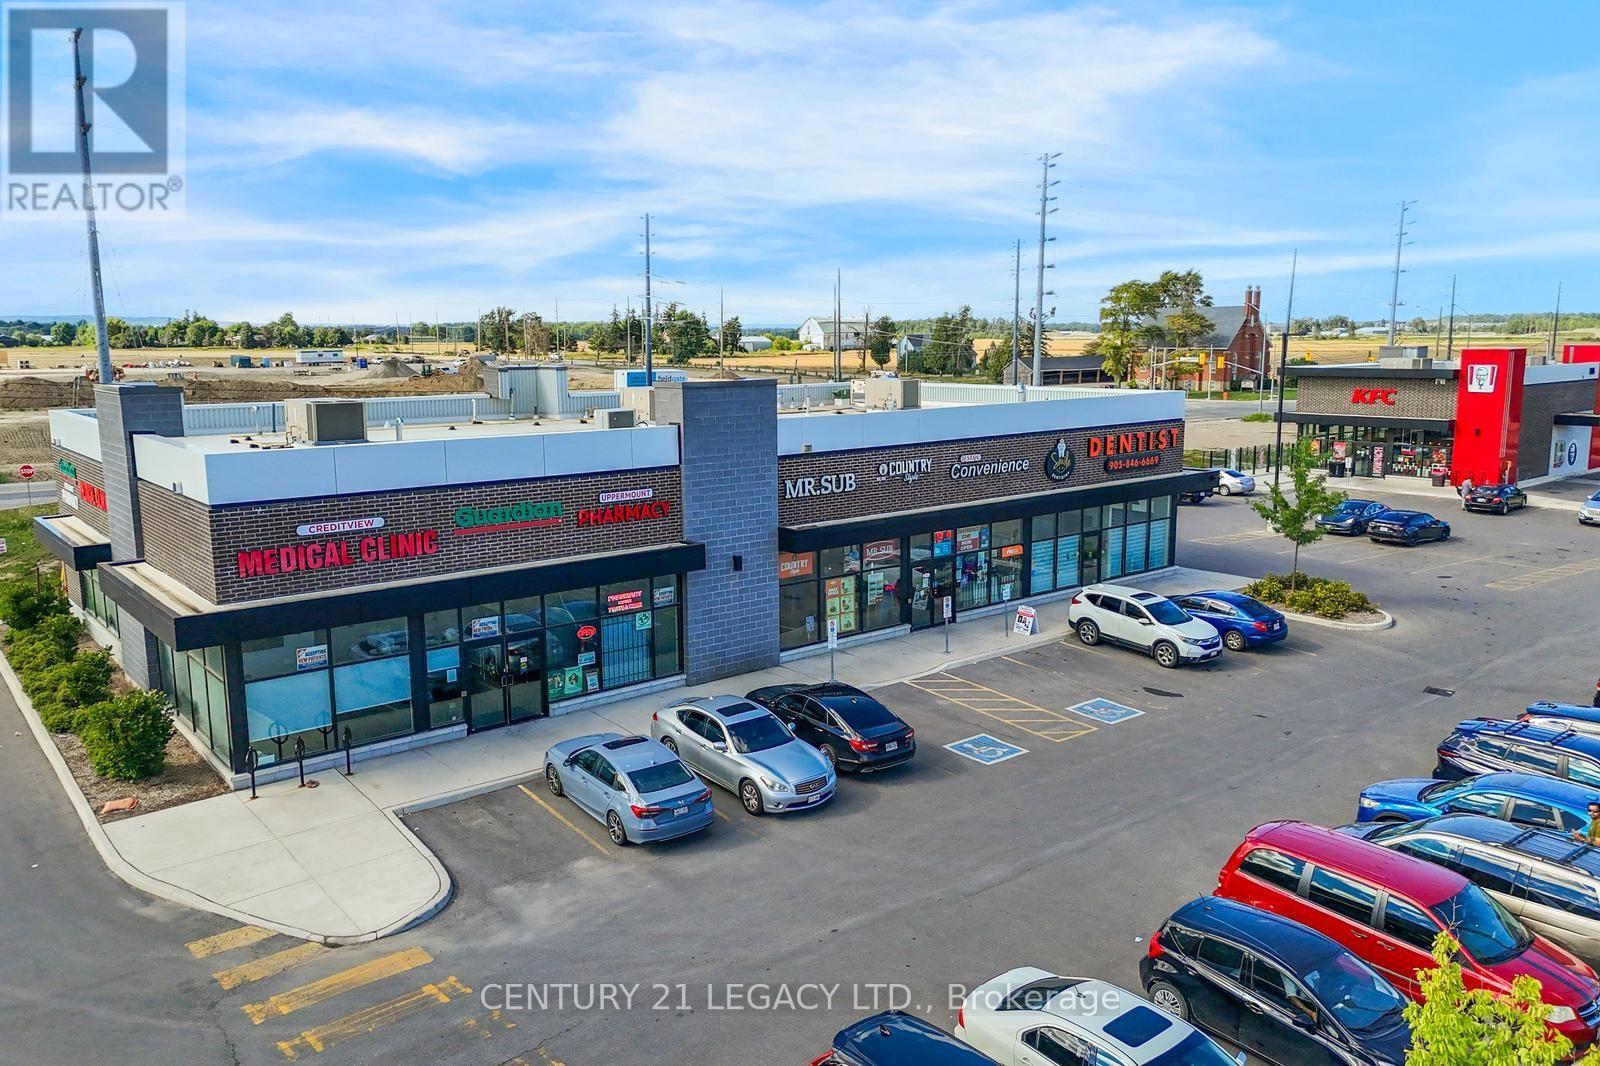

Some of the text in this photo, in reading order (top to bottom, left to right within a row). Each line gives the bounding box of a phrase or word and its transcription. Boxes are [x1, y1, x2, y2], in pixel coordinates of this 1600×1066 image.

[1351, 386, 1397, 406] KFC
[1088, 428, 1179, 457] DENTIST
[20, 467, 34, 475] STOP
[889, 458, 933, 476] COUNTRY
[951, 459, 1030, 479] Convenience
[1109, 455, 1159, 470] 905-846-6669
[785, 473, 857, 499] MR.SUB
[903, 471, 920, 484] Style
[601, 489, 651, 502] UPPERMOUNT
[454, 501, 564, 528] Guardian
[577, 500, 671, 527] PHARMACY
[308, 519, 375, 534] CREDITVIEW
[237, 529, 438, 579] MEDICAL CLINIC
[780, 558, 809, 572] COUNTRY
[579, 628, 594, 637] OPEN
